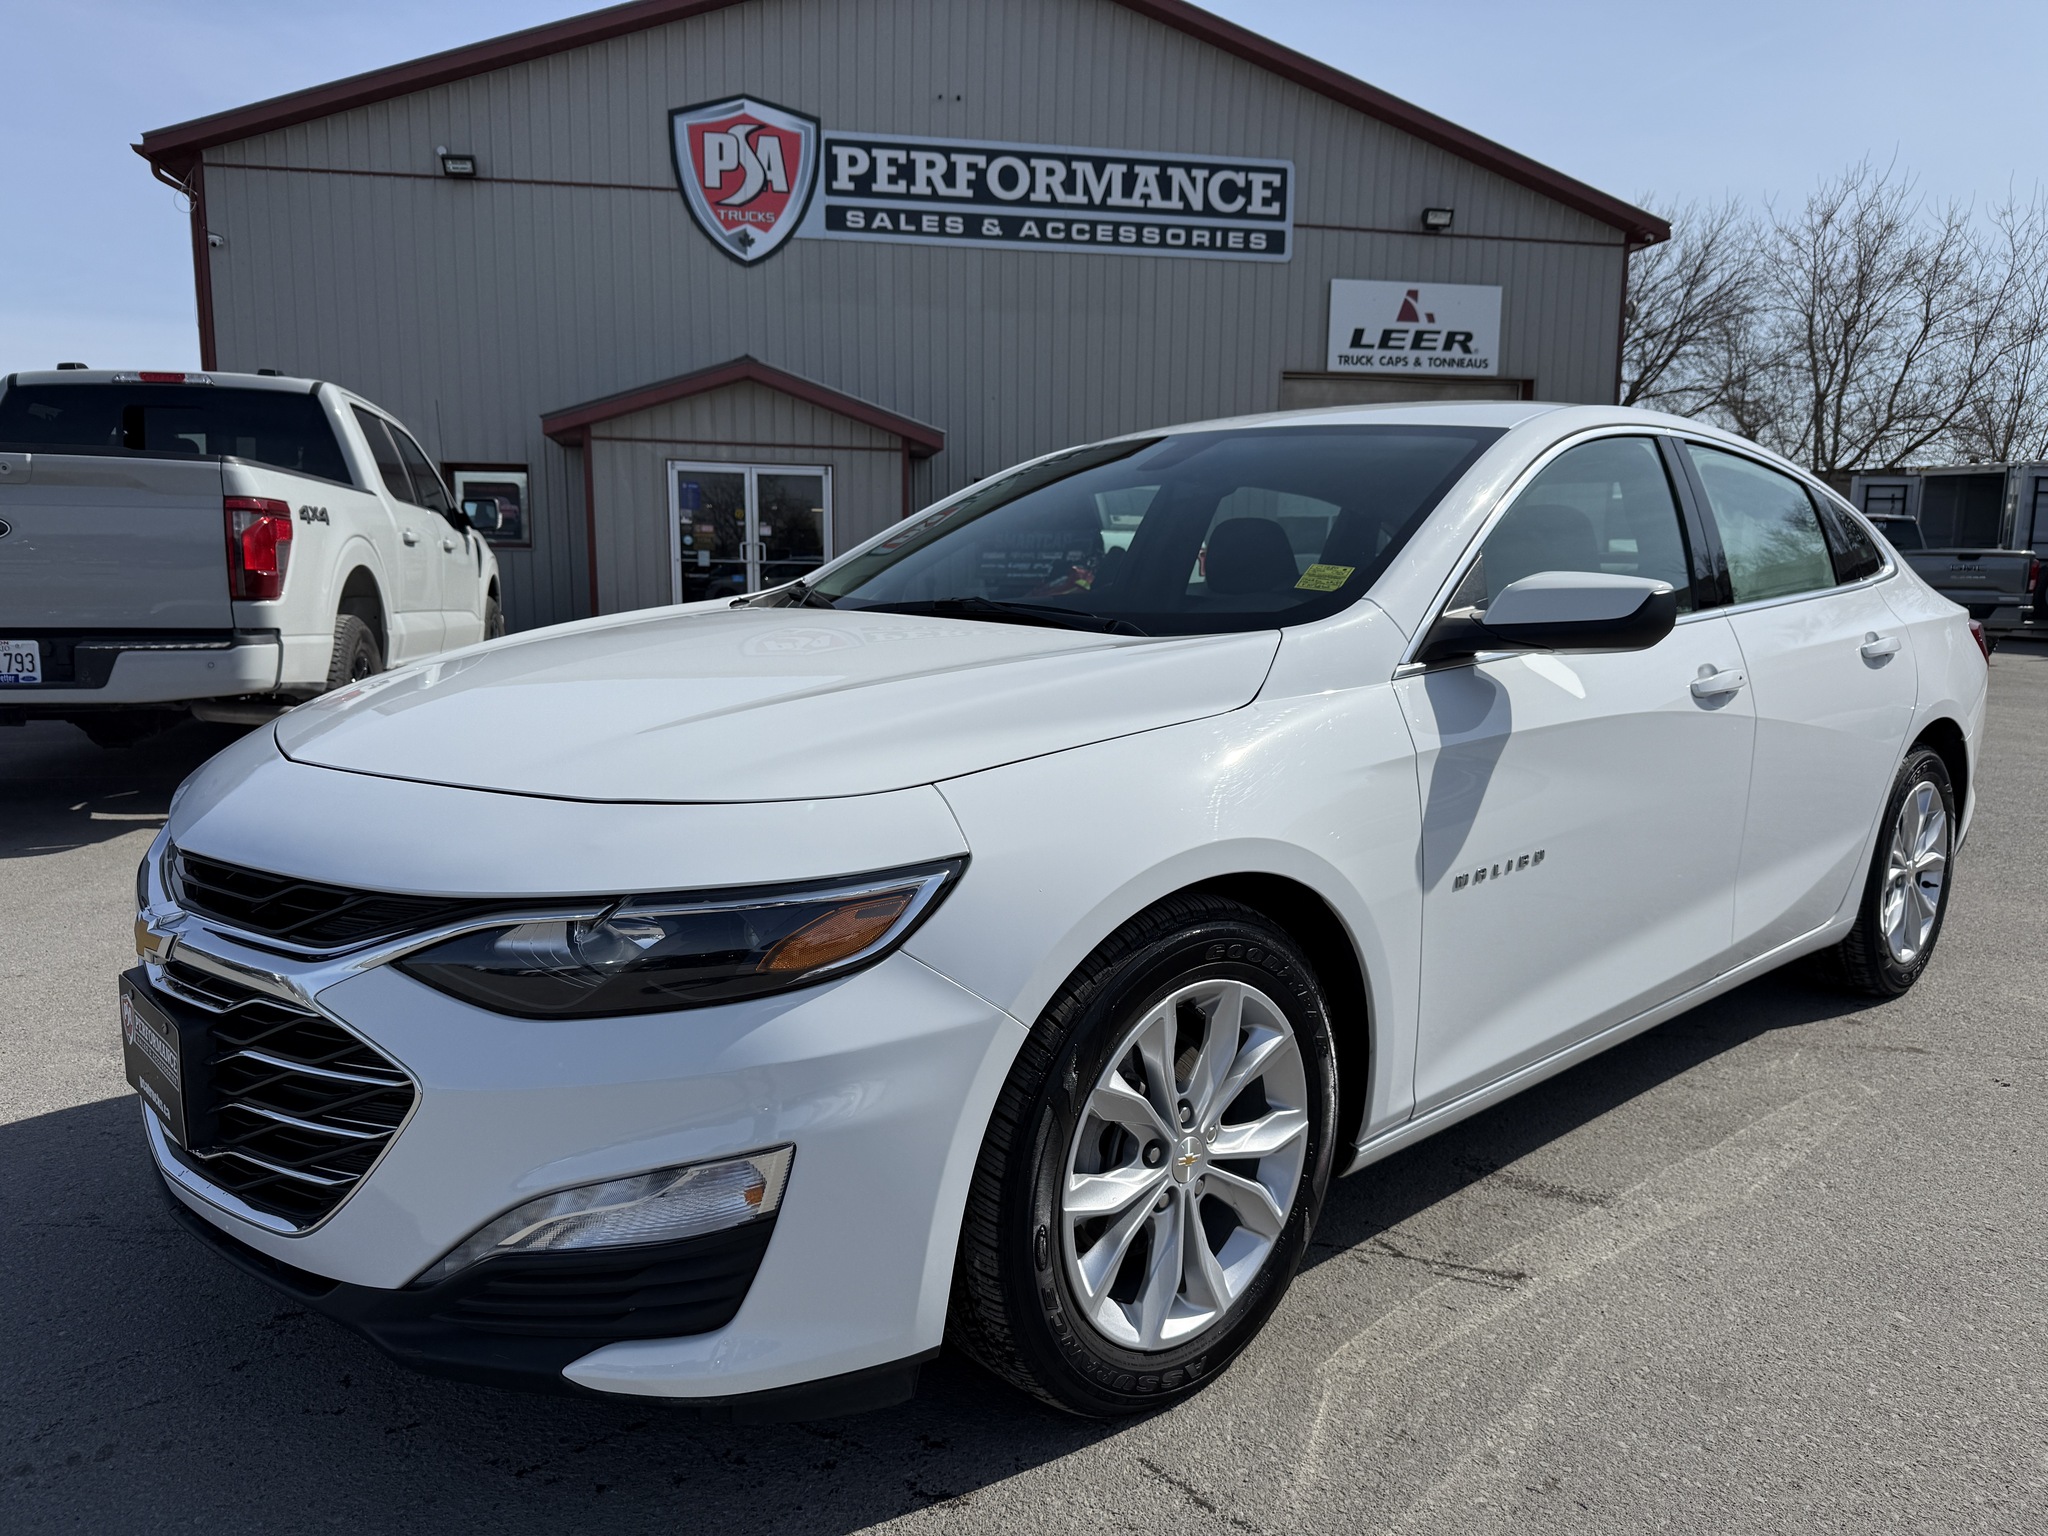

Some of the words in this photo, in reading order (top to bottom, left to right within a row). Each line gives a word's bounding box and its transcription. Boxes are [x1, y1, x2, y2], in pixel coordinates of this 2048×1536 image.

[702, 123, 791, 207] PSA
[831, 145, 1282, 217] PERFORMANCE
[717, 208, 776, 223] TRUCKS
[845, 209, 966, 237] SALES
[981, 217, 1003, 238] &
[1018, 220, 1269, 252] ACCESSORIES
[1349, 327, 1474, 355] LEER
[1338, 354, 1374, 367] TRUCK
[1379, 355, 1409, 367] CAPS
[1413, 356, 1422, 368] &
[1427, 356, 1489, 369] TONNEAUS
[0, 652, 35, 673] 793
[135, 1014, 178, 1072] PERFORMANCE
